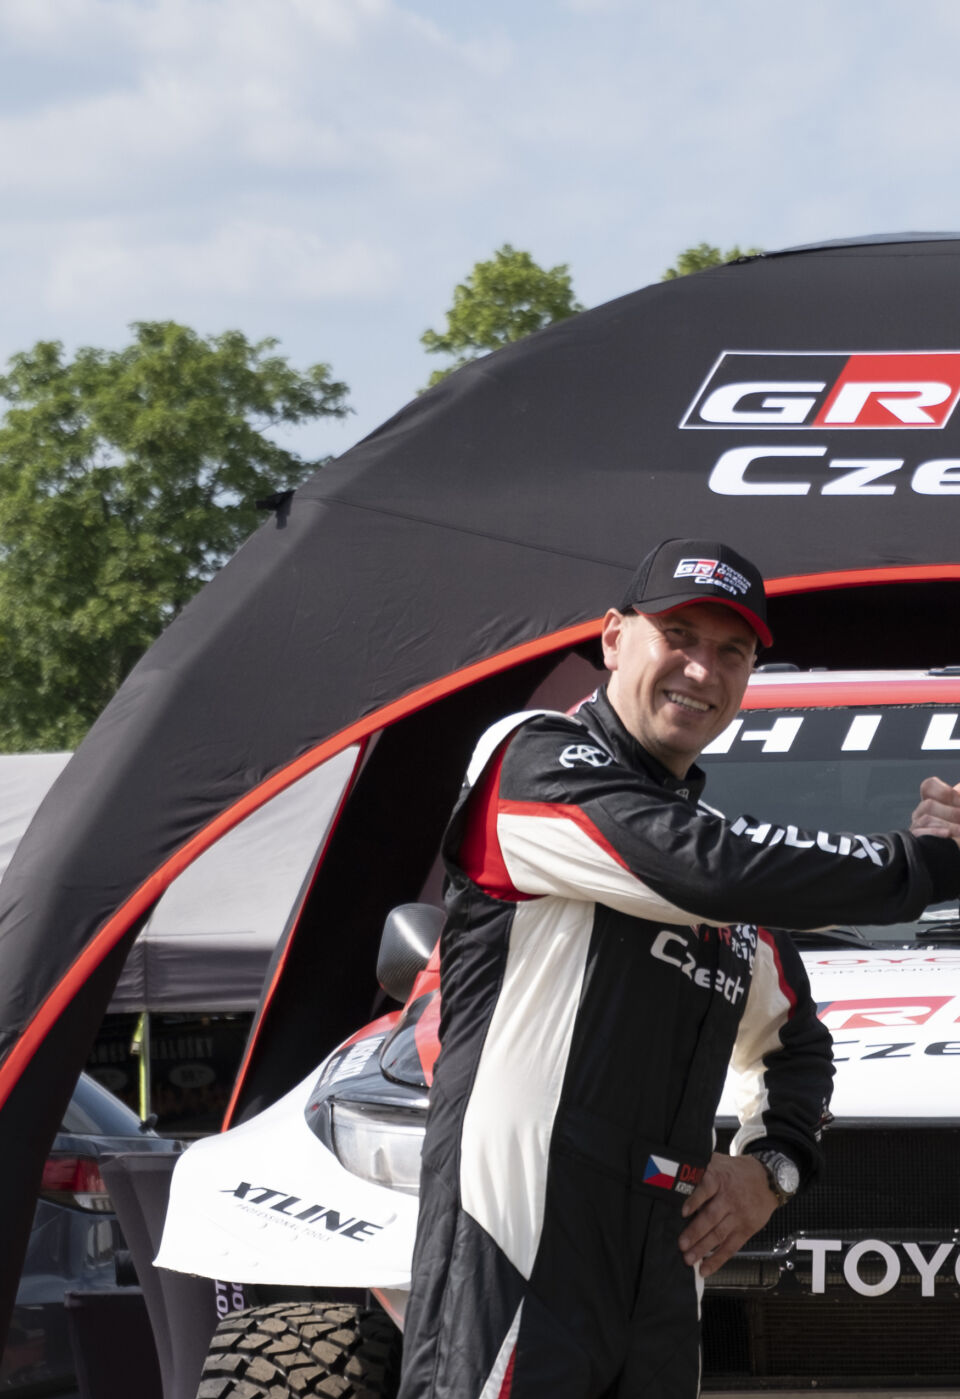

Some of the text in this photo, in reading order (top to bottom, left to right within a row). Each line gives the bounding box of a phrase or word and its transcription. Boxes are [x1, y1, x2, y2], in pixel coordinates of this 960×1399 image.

[698, 381, 953, 424] GR
[694, 576, 737, 596] Czech
[730, 816, 887, 867] HILUX
[650, 930, 745, 1005] Czech
[219, 1182, 384, 1242] XTLINE
